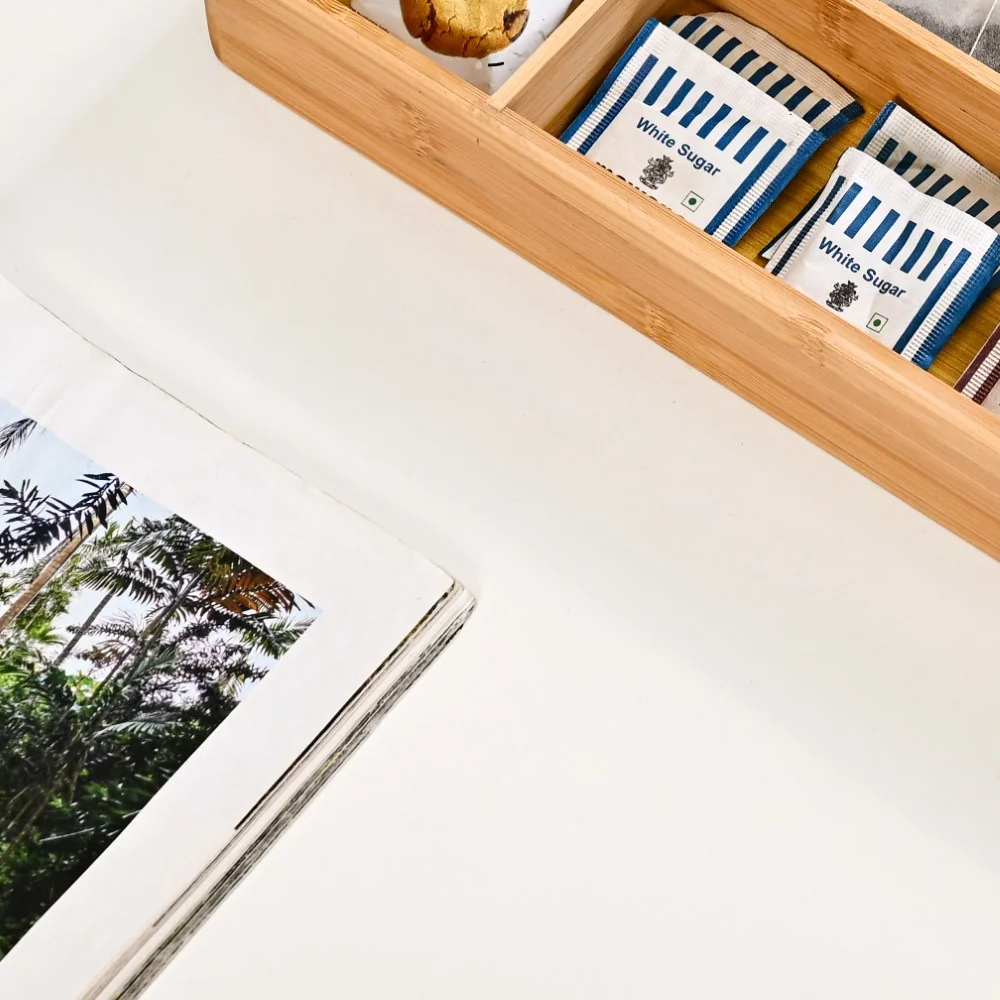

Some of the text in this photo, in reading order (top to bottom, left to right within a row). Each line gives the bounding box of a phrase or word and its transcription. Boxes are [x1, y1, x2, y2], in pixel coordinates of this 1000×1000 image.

[636, 116, 721, 176] White Sugar
[818, 236, 906, 298] White Sugar
